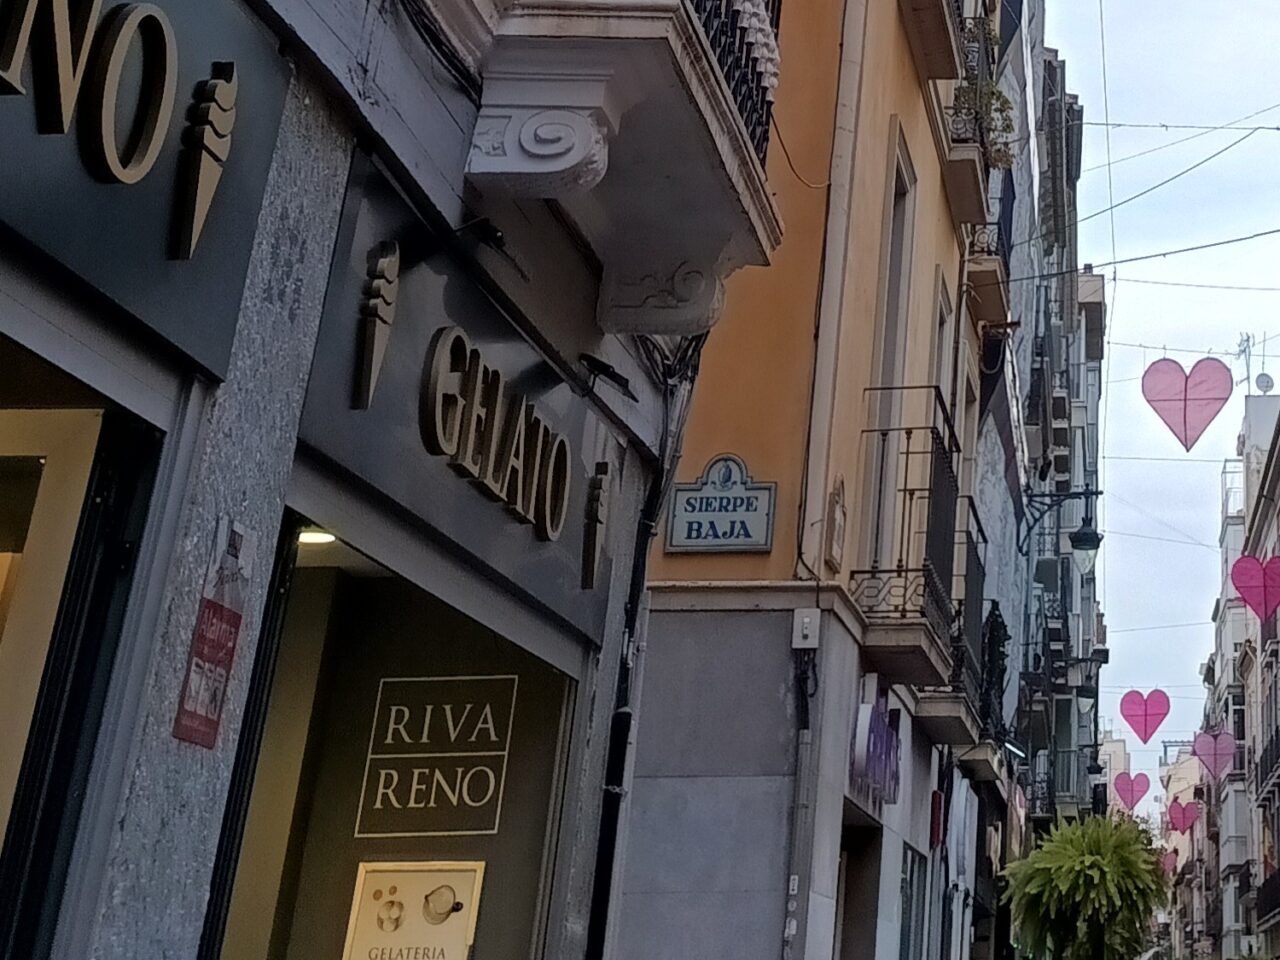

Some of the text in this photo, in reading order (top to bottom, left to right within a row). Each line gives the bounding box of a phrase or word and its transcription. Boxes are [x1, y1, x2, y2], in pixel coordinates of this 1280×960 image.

[424, 326, 571, 541] GELATO
[684, 496, 758, 513] SIERPE
[686, 521, 752, 540] BAJA
[385, 703, 499, 744] RIVA
[373, 767, 495, 809] RENO
[368, 946, 446, 960] GELATERIA
